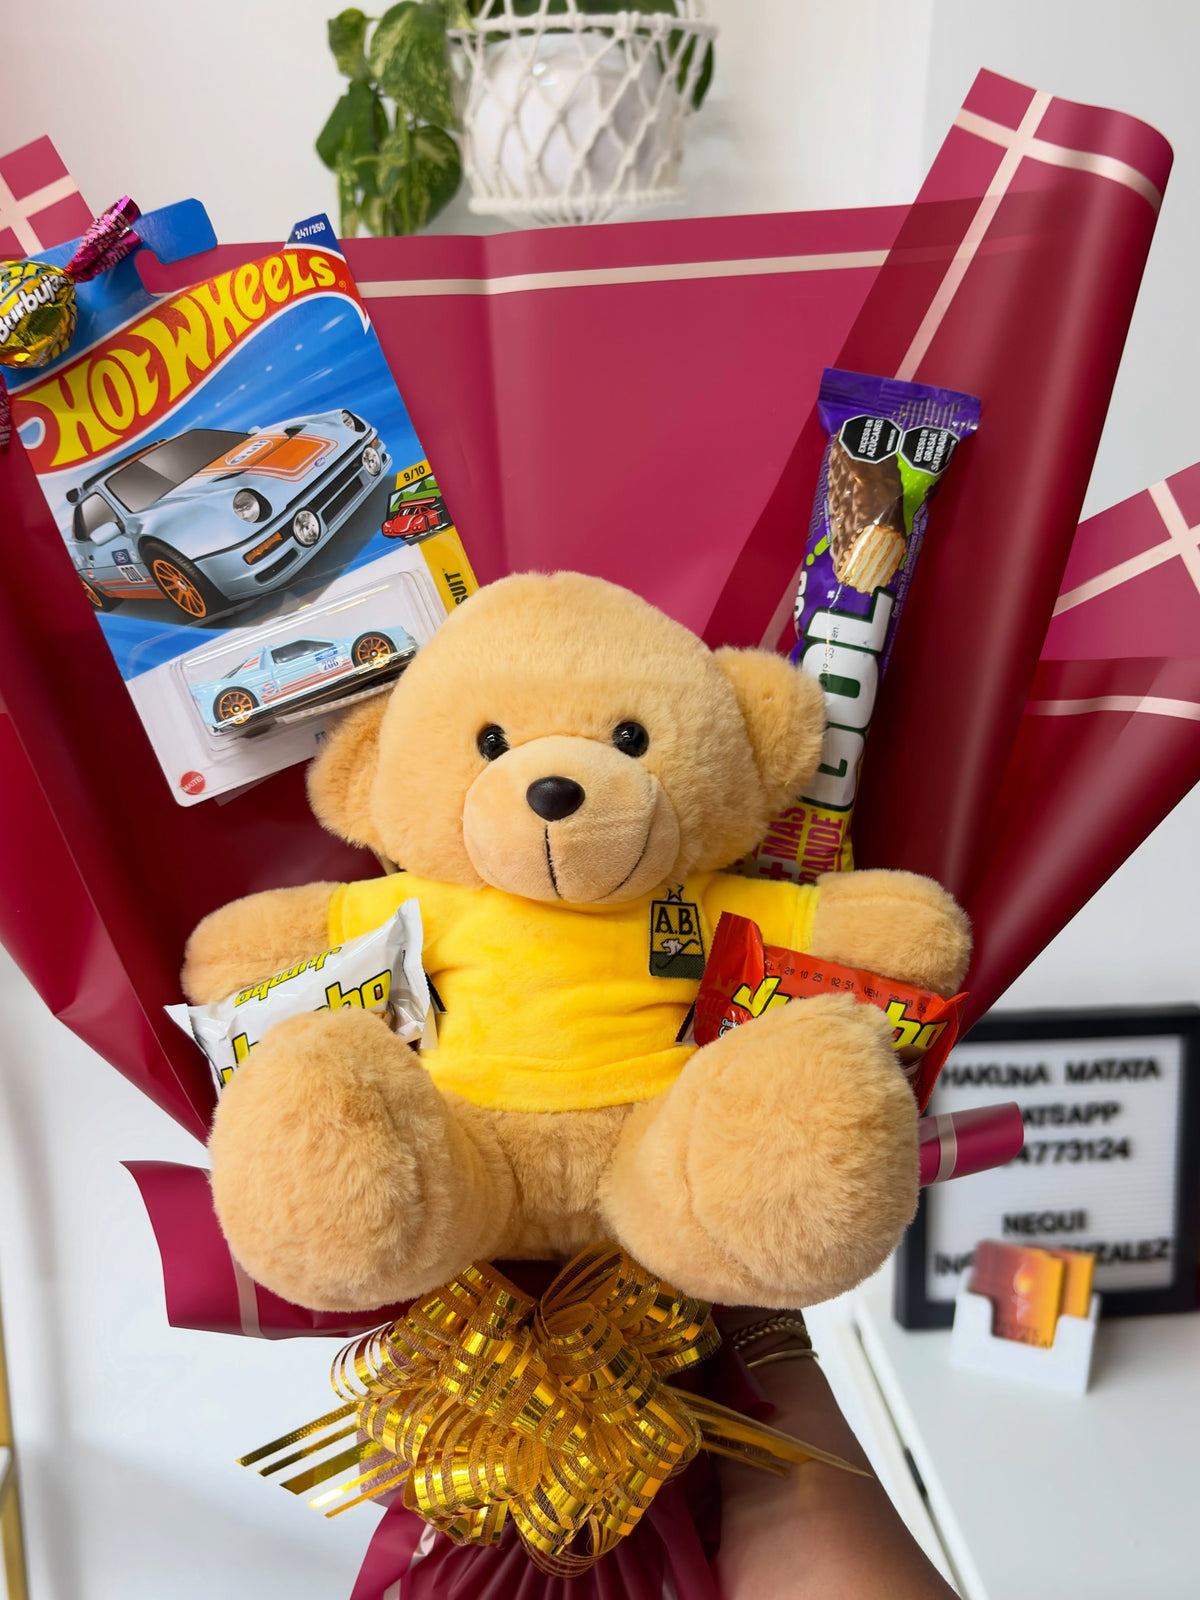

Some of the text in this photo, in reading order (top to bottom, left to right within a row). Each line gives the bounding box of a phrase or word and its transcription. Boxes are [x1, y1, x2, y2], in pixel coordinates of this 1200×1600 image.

[295, 222, 326, 240] 247/250
[12, 347, 161, 467] HOT
[857, 419, 874, 454] EXCESO EN
[913, 437, 927, 462] EXCESO
[923, 432, 938, 462] GRASAS
[930, 431, 949, 472] SATURADAS
[403, 465, 425, 482] 9/10
[444, 572, 469, 606] SUIT
[182, 775, 204, 793] MATTEL
[799, 813, 843, 887] RANDE
[800, 970, 809, 979] 10
[812, 972, 824, 983] 25
[941, 1058, 1162, 1088] HAKUNA MATATA
[1022, 1102, 1121, 1127] ATSAPP
[1014, 1138, 1131, 1166] 4773124
[1002, 1210, 1089, 1236] NEQUI
